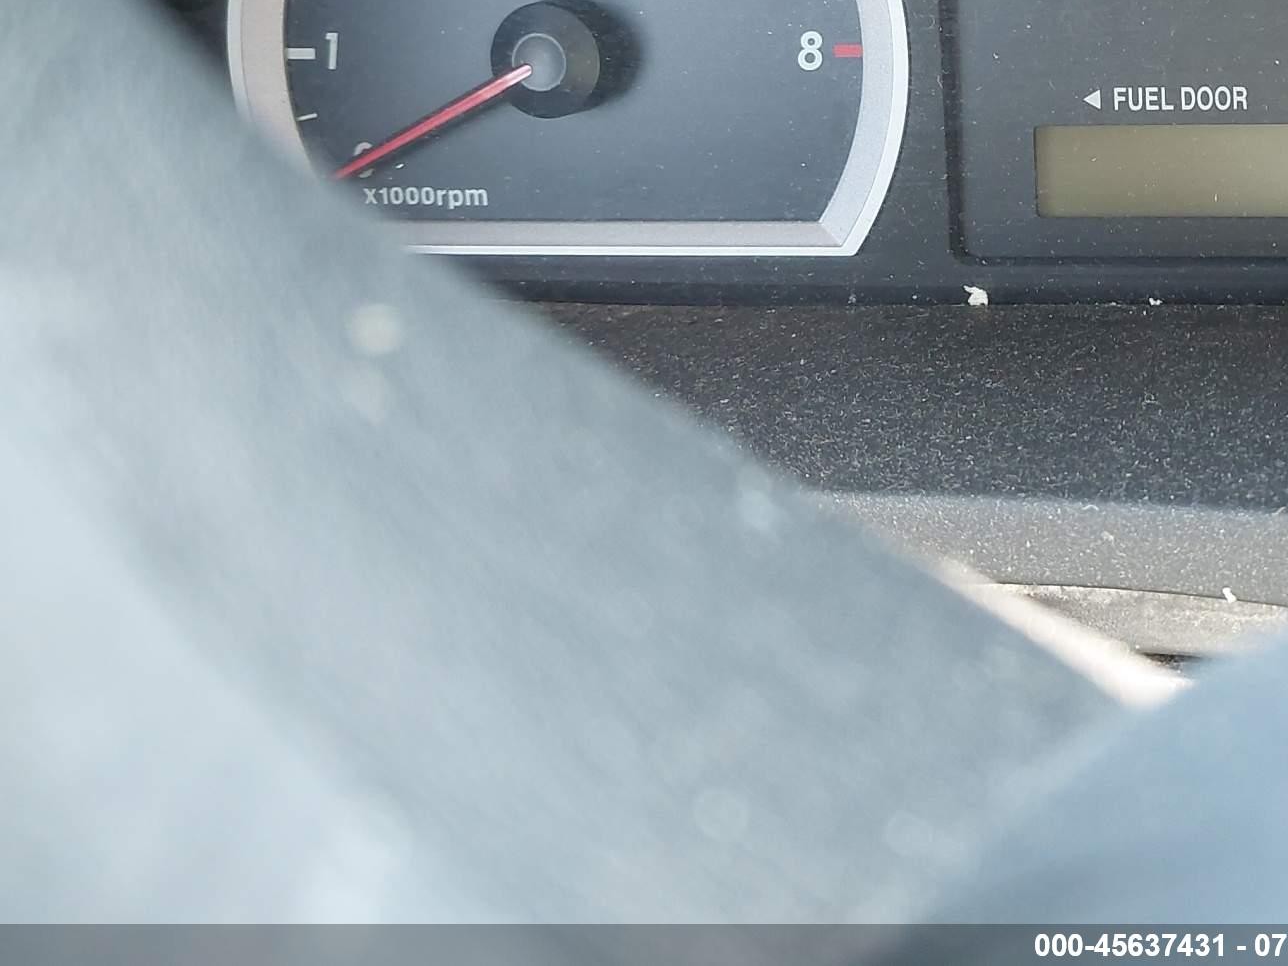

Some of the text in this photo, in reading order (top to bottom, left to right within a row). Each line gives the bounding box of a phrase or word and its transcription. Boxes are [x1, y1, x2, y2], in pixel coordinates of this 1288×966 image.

[325, 32, 339, 70] 1
[797, 30, 823, 71] 8
[1113, 85, 1248, 111] FUEL DOOR
